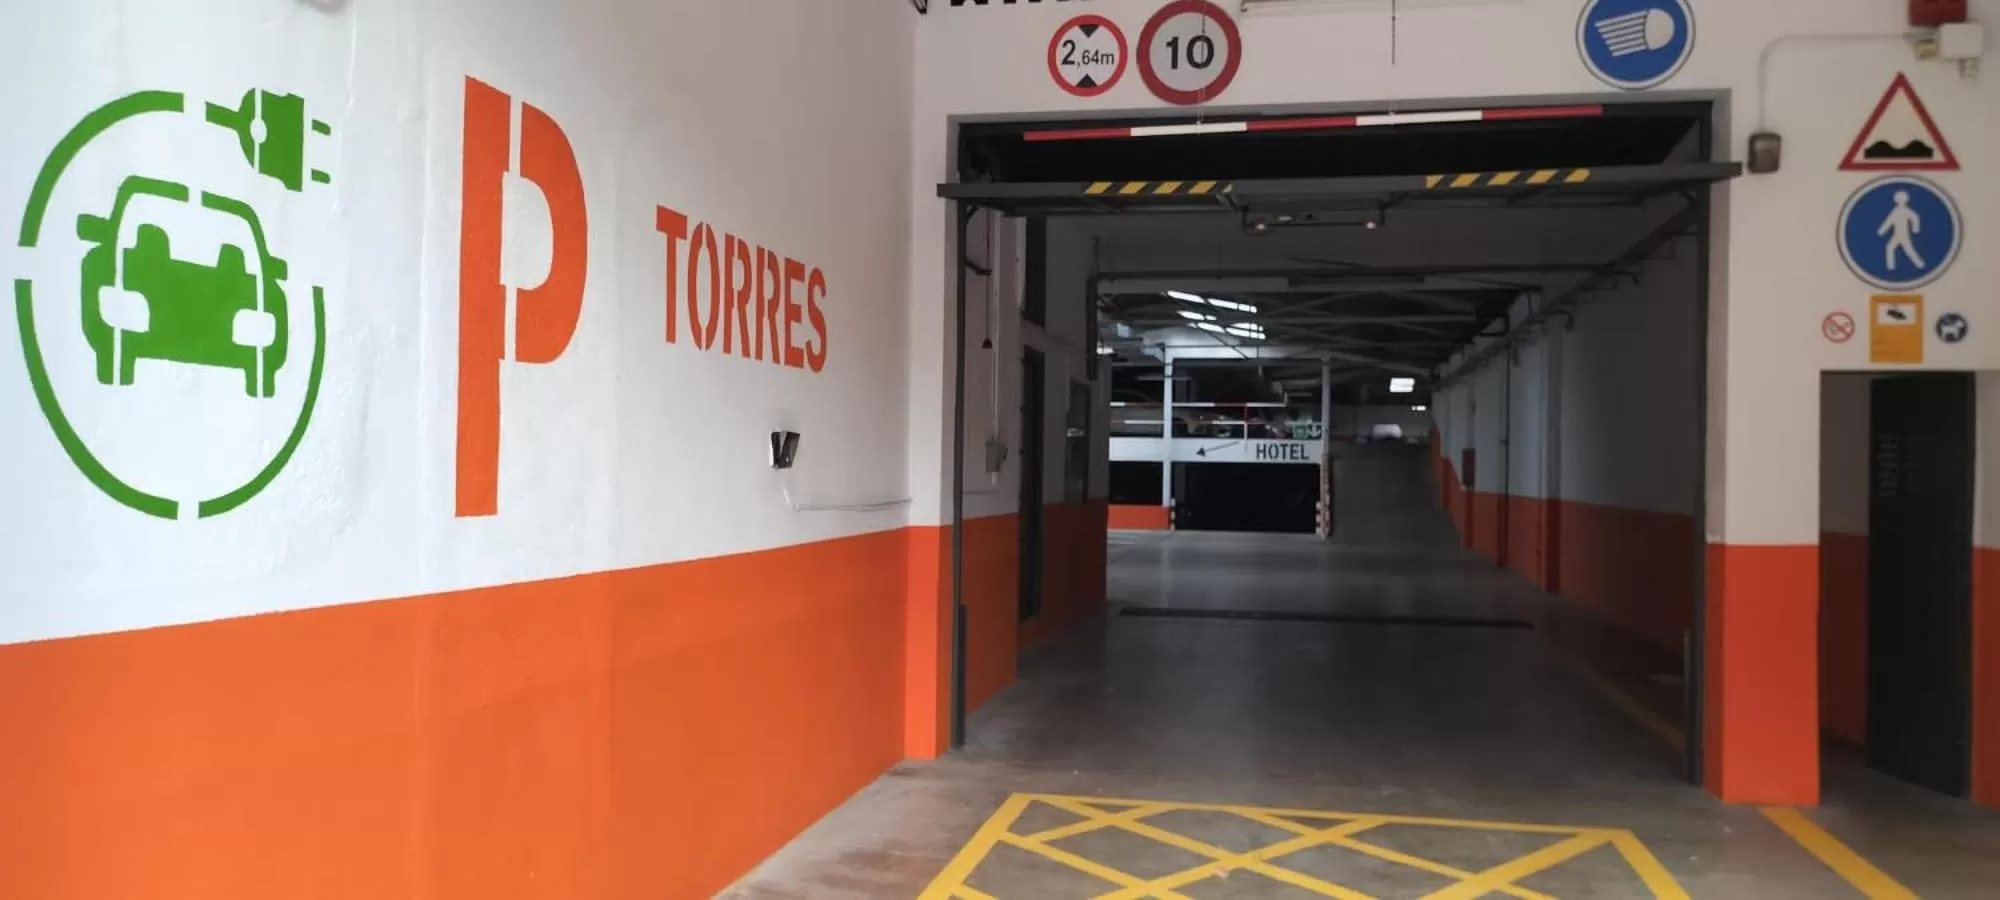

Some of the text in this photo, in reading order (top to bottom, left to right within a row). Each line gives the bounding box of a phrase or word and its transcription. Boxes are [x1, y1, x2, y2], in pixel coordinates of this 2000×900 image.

[1165, 35, 1215, 70] 10
[455, 75, 828, 518] P TORRES
[1255, 443, 1311, 460] HOTEL
